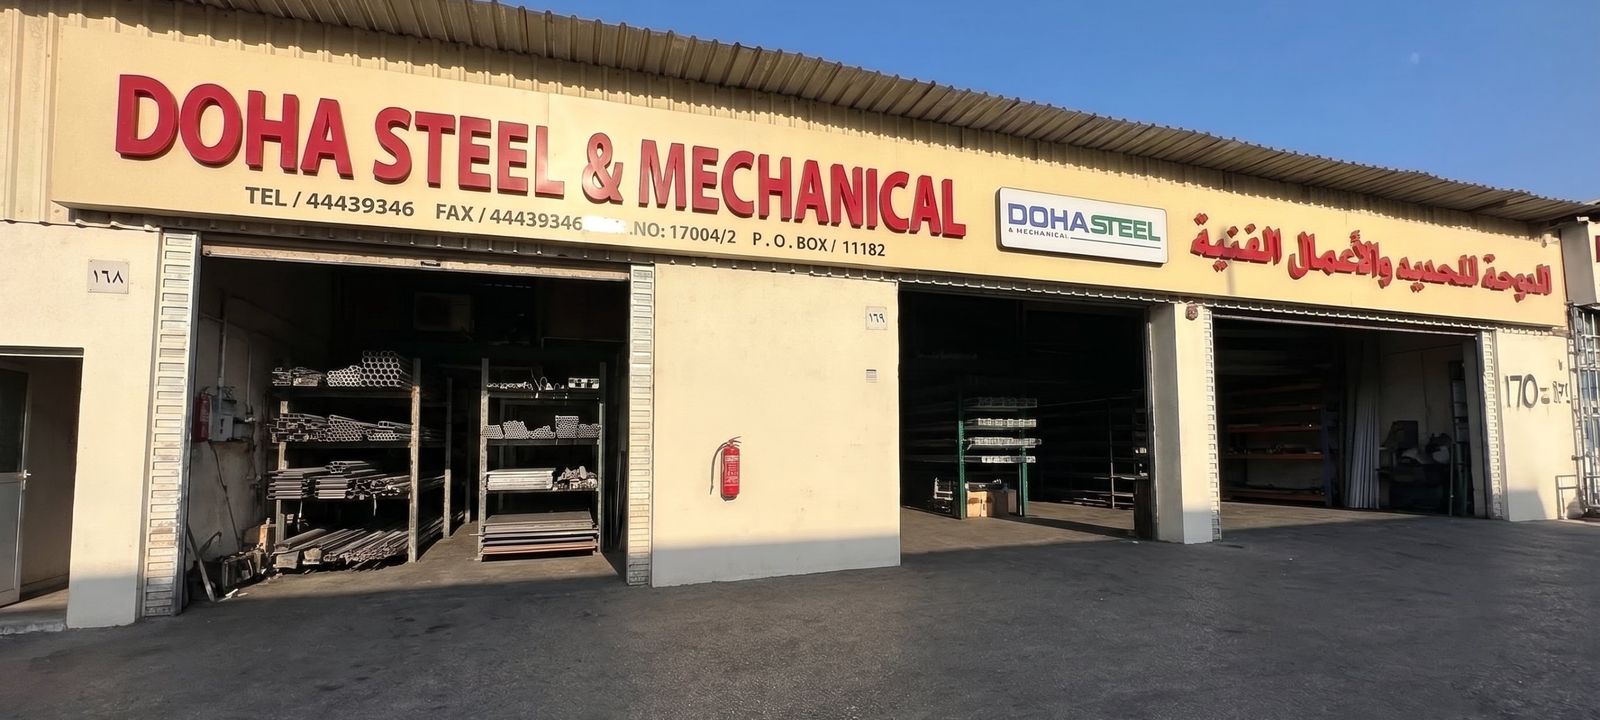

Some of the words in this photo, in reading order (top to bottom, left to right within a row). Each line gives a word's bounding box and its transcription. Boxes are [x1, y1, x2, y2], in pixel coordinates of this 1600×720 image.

[115, 73, 354, 181] DOHA
[372, 106, 565, 199] STEEL
[581, 131, 624, 206] &
[638, 138, 967, 240] MECHANICAL
[245, 186, 288, 207] TEL
[306, 192, 415, 217] 44439346
[435, 203, 474, 223] FAX
[490, 208, 583, 231] 44439346
[670, 224, 737, 245] 17004/2
[1016, 228, 1070, 239] MECHANICAL
[1189, 212, 1283, 273] الفنية
[842, 240, 886, 257] 11182
[1287, 229, 1394, 290] والأعمال
[93, 269, 124, 284] ١٦٨
[1395, 253, 1479, 293] للحديد
[1481, 253, 1553, 303] الدوحة
[869, 312, 886, 324] ١٦٩
